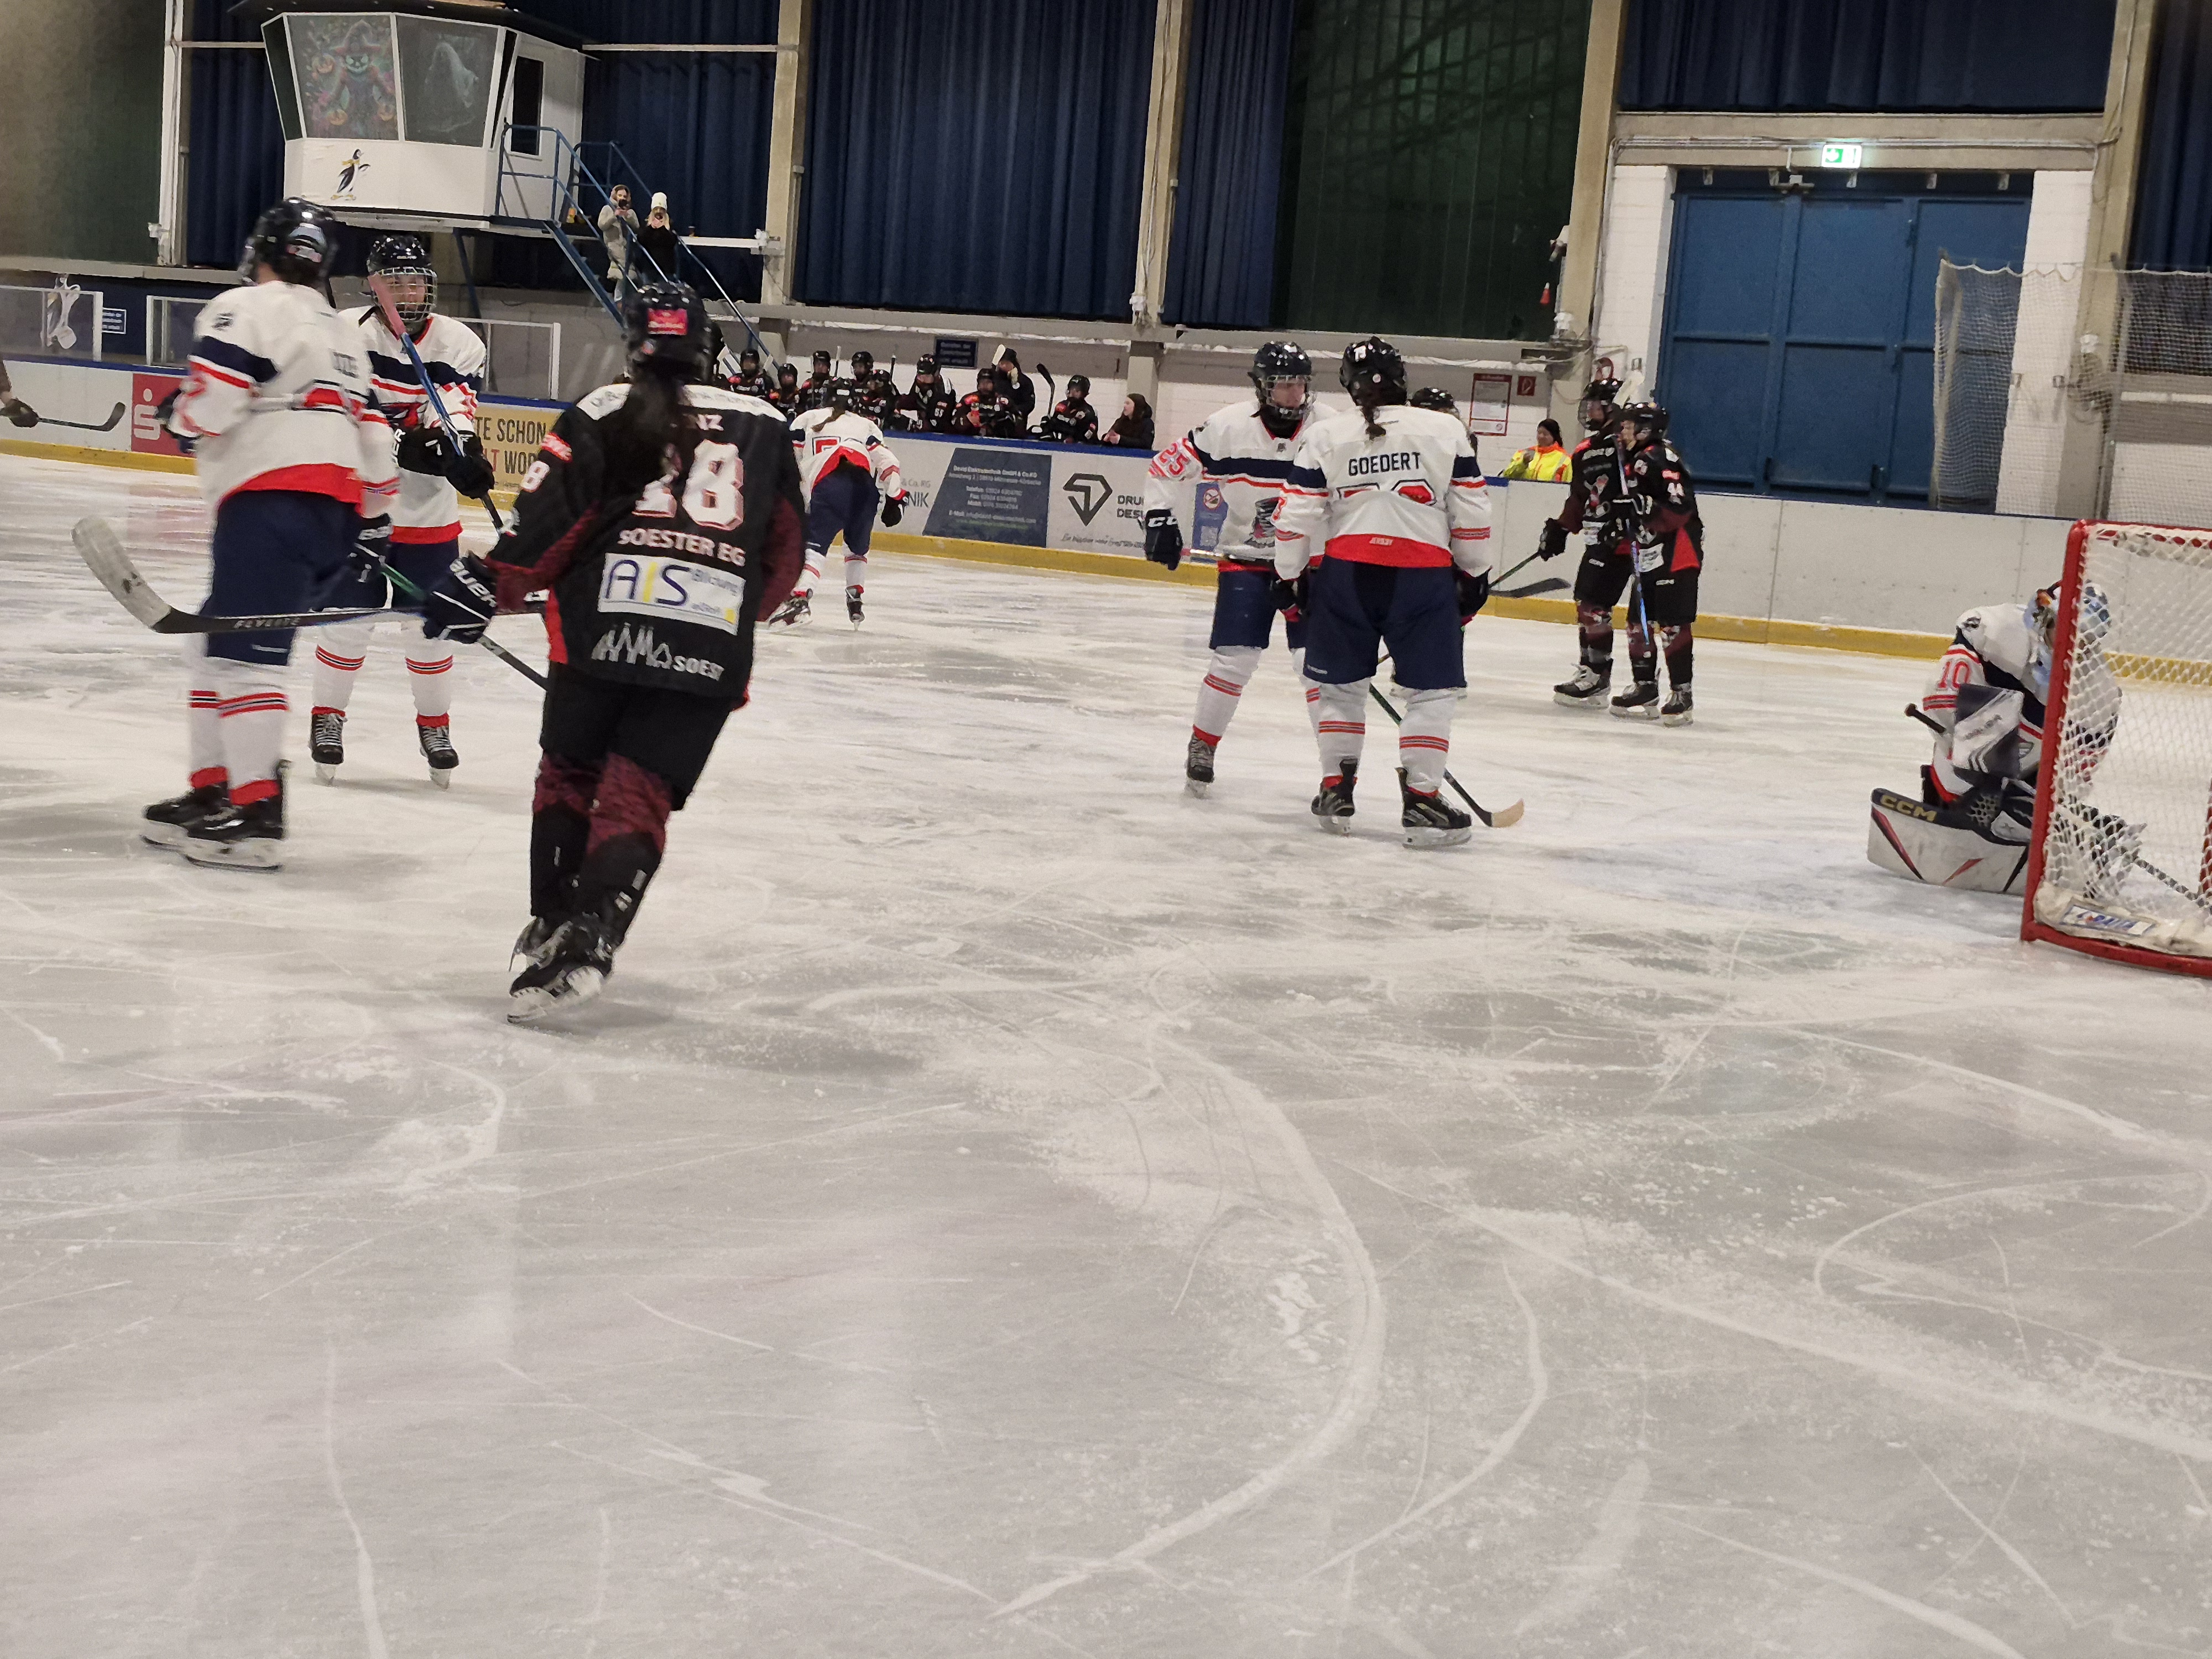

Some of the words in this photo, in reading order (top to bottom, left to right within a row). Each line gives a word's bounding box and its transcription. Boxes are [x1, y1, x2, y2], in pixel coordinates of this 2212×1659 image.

[497, 418, 546, 445] SCHON
[1158, 442, 1191, 477] 25
[1348, 451, 1421, 477] GOEDERT
[617, 527, 716, 557] SOESTER
[1937, 661, 1971, 689] 10
[1881, 794, 1938, 822] CCM
